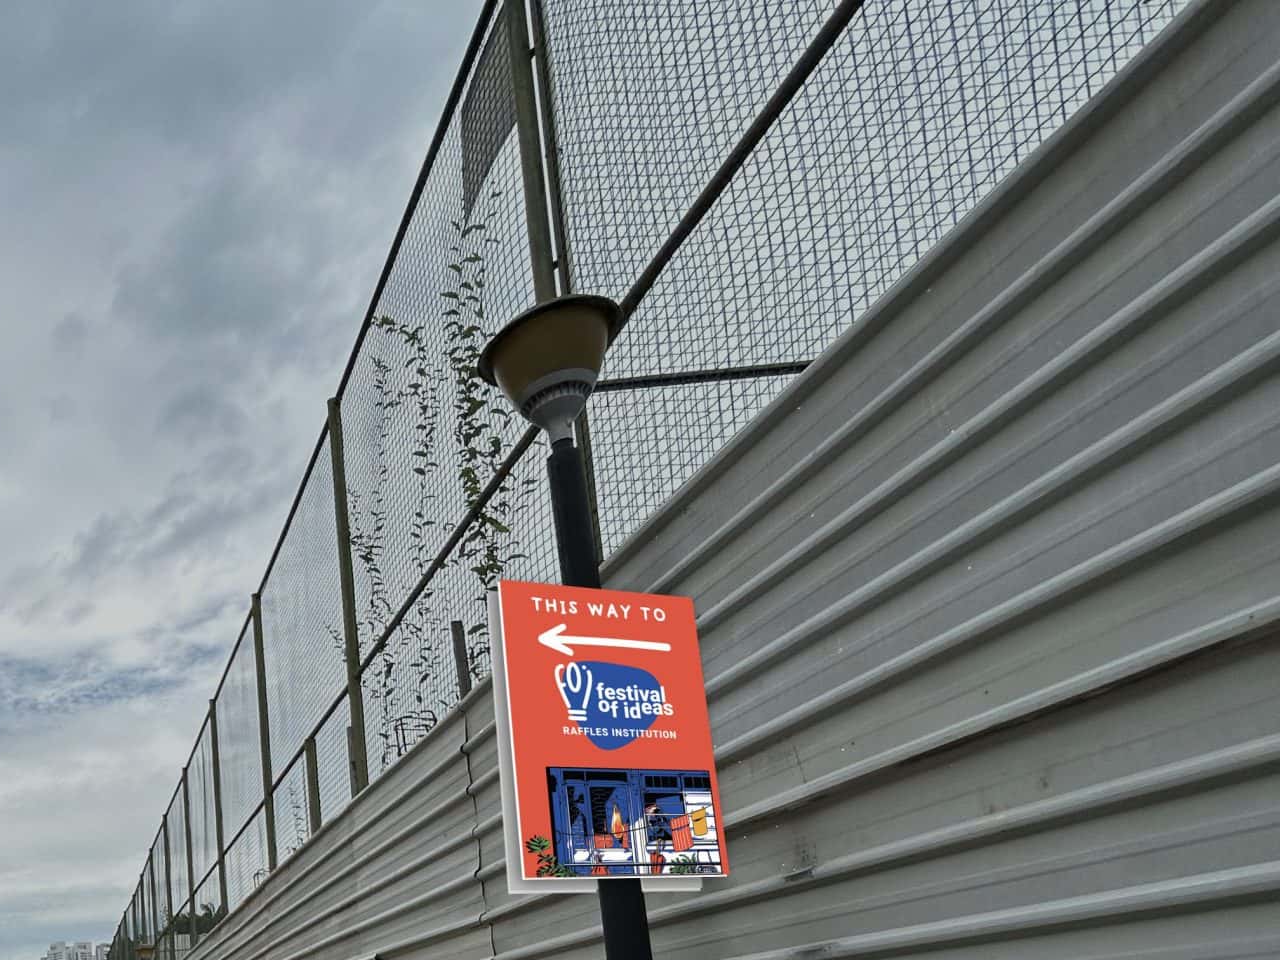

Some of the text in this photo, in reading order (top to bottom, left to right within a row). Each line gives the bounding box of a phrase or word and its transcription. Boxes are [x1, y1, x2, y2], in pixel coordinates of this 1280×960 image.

[531, 596, 666, 622] THIS WAY TO
[596, 682, 666, 703] festival
[598, 700, 674, 719] of ideas
[562, 726, 677, 739] RAFFLES INSTITUTION
